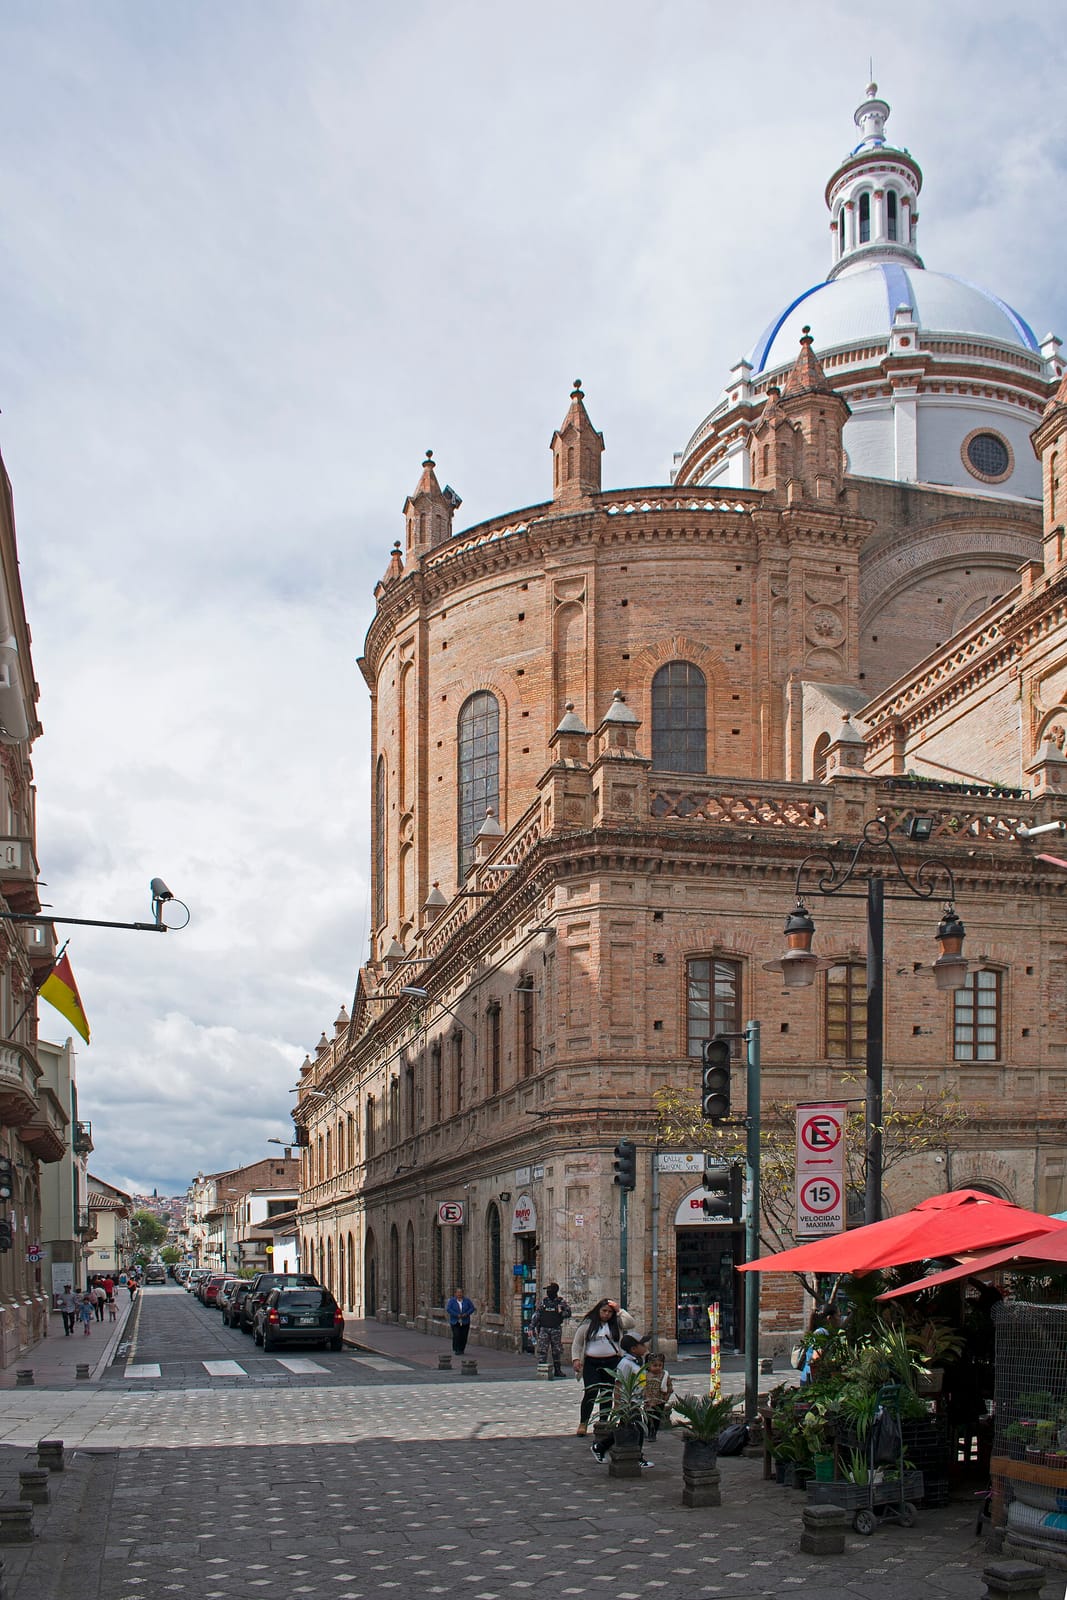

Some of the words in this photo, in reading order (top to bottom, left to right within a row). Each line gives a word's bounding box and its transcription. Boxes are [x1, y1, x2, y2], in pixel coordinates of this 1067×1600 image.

[812, 1122, 833, 1145] E
[809, 1187, 830, 1202] 15
[446, 1207, 457, 1219] E
